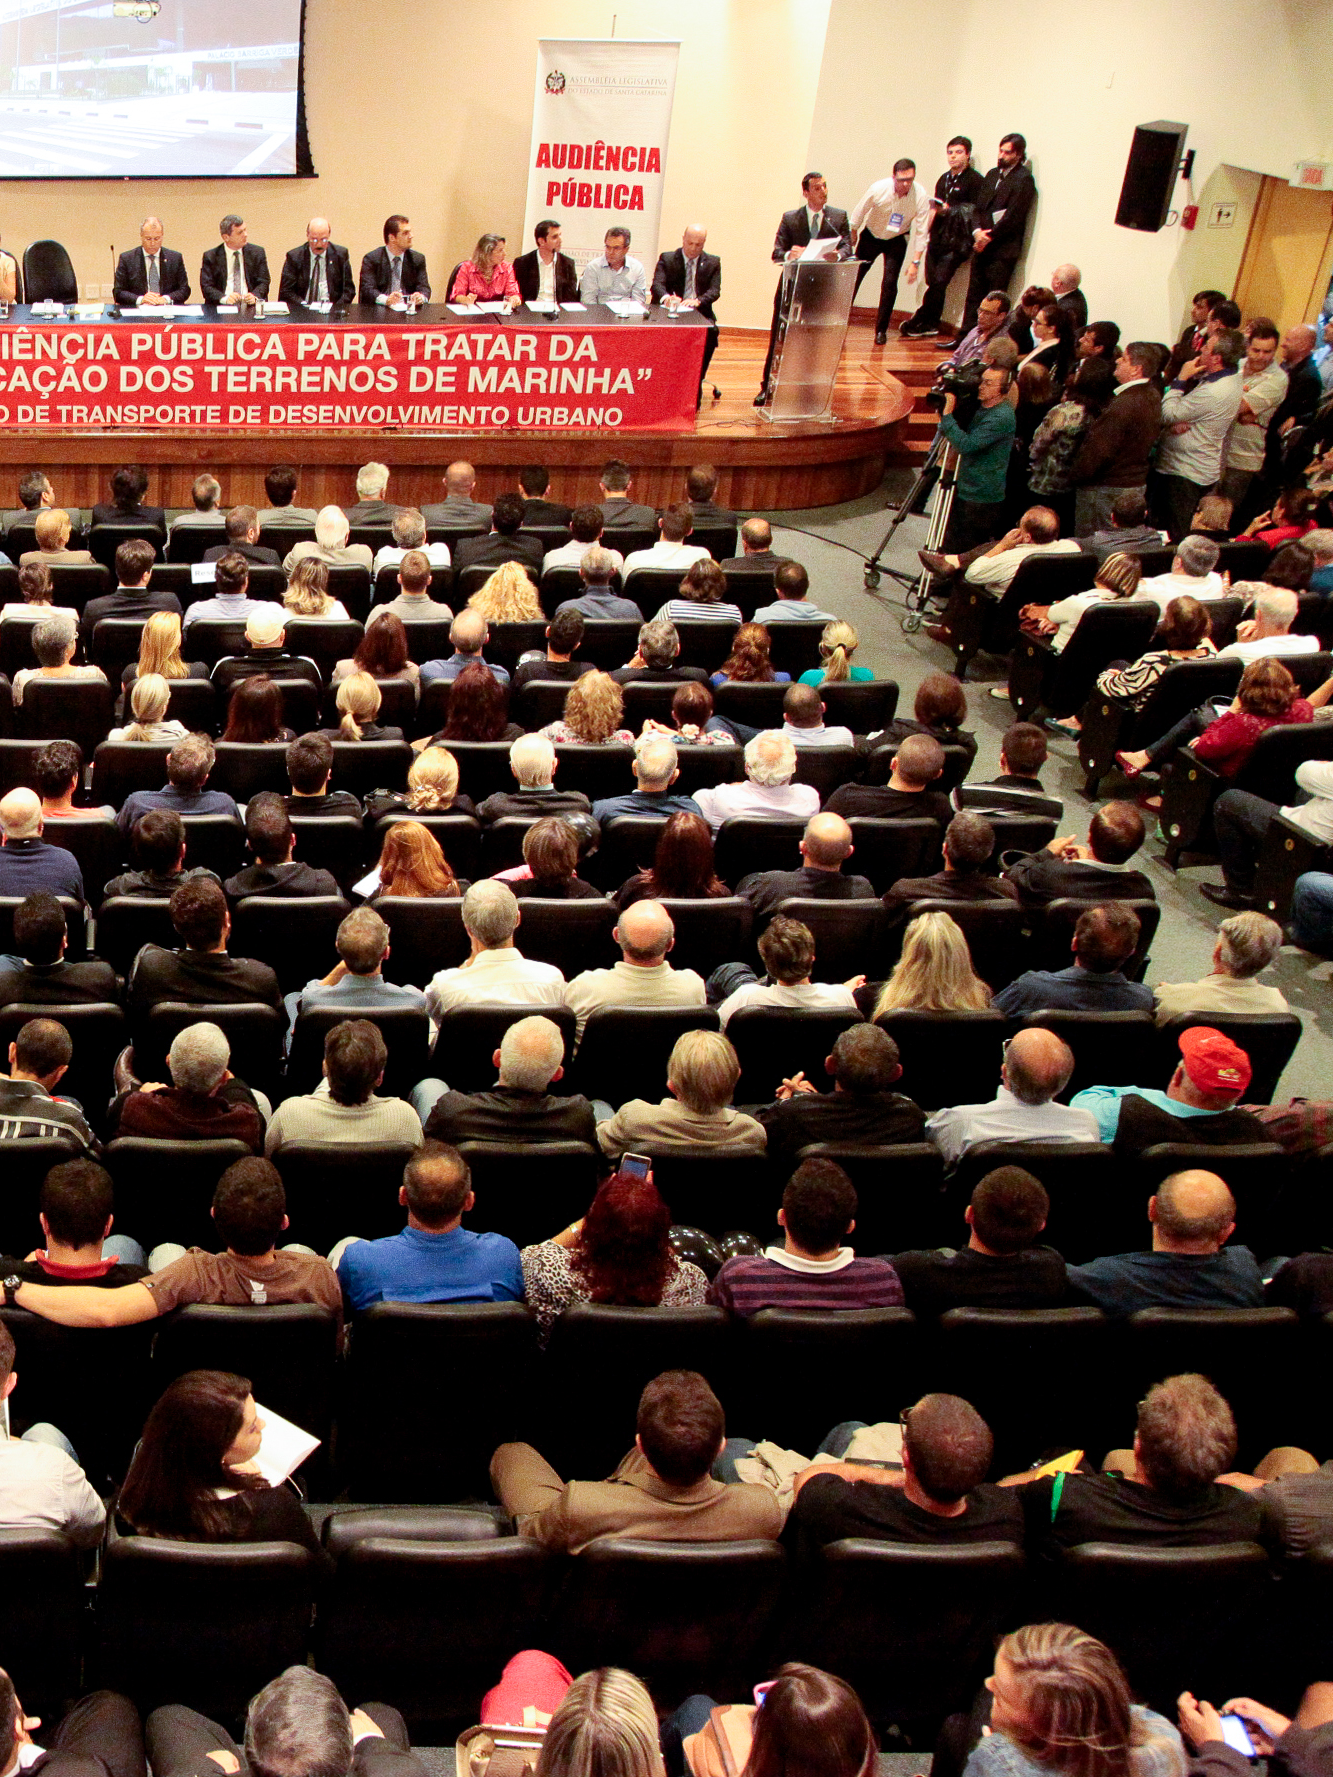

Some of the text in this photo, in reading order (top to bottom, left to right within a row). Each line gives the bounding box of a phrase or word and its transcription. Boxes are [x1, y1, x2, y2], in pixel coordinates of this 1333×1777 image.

[535, 140, 661, 173] AUDIÊNCIA
[546, 177, 644, 211] PÚBLICA
[130, 325, 287, 361] PÚBLICA
[297, 332, 392, 361] PARA
[401, 332, 538, 361] TRATAR
[548, 334, 598, 361] DA
[119, 365, 195, 393] DOS
[203, 364, 398, 393] TERRENOS
[408, 366, 458, 393] DE
[467, 366, 653, 395] MARINHA”
[17, 405, 50, 424] DE
[56, 404, 222, 424] TRANSPORTE
[228, 405, 262, 424] DE
[268, 404, 510, 425] DESENVOLVIMENTO
[517, 406, 623, 427] URBANO
